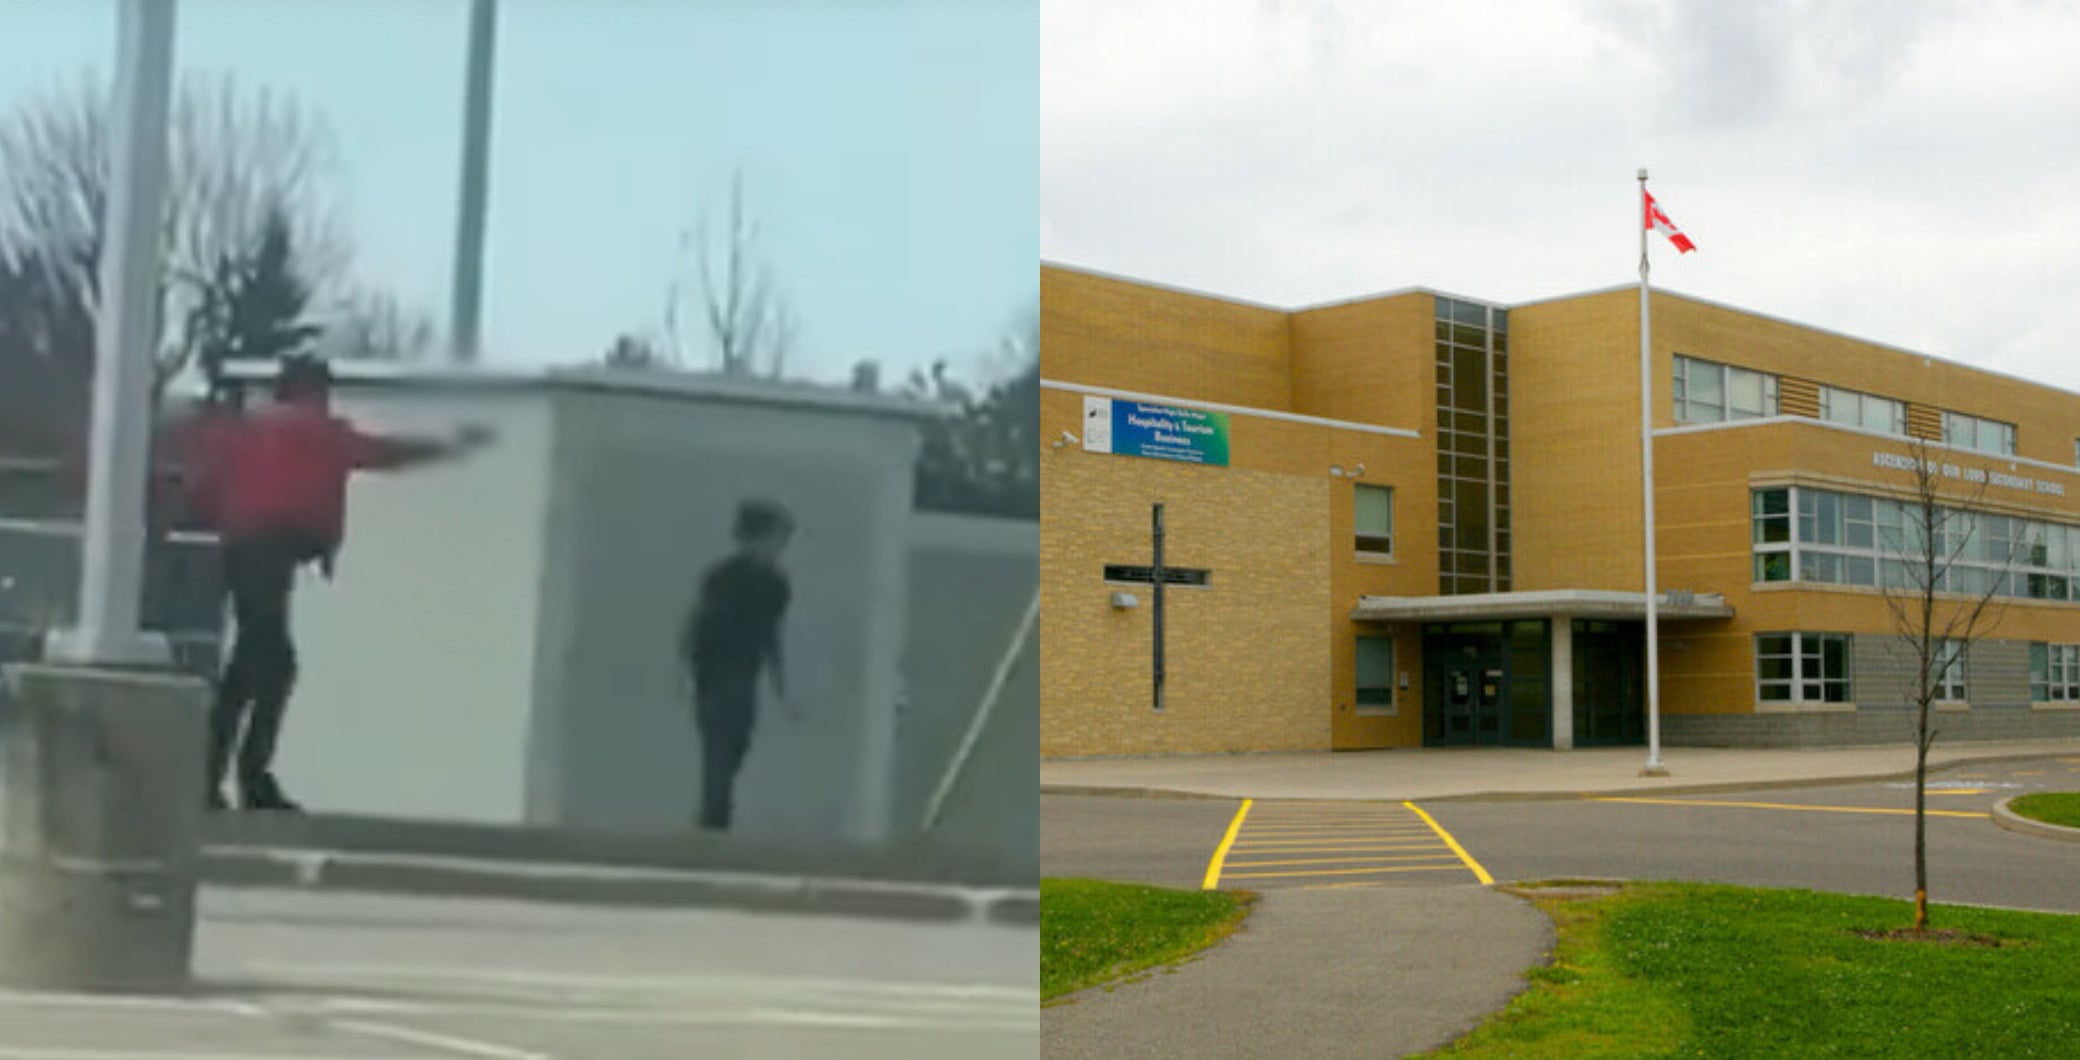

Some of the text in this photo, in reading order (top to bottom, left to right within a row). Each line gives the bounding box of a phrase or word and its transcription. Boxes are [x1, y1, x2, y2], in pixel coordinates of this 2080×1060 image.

[1128, 413, 1173, 432] Hospitality
[1182, 420, 1214, 435] Tourism
[1155, 431, 1191, 446] Business
[1942, 463, 1960, 478] OUR
[1963, 466, 1985, 483] LORD
[2035, 479, 2065, 496] SCHOOL
